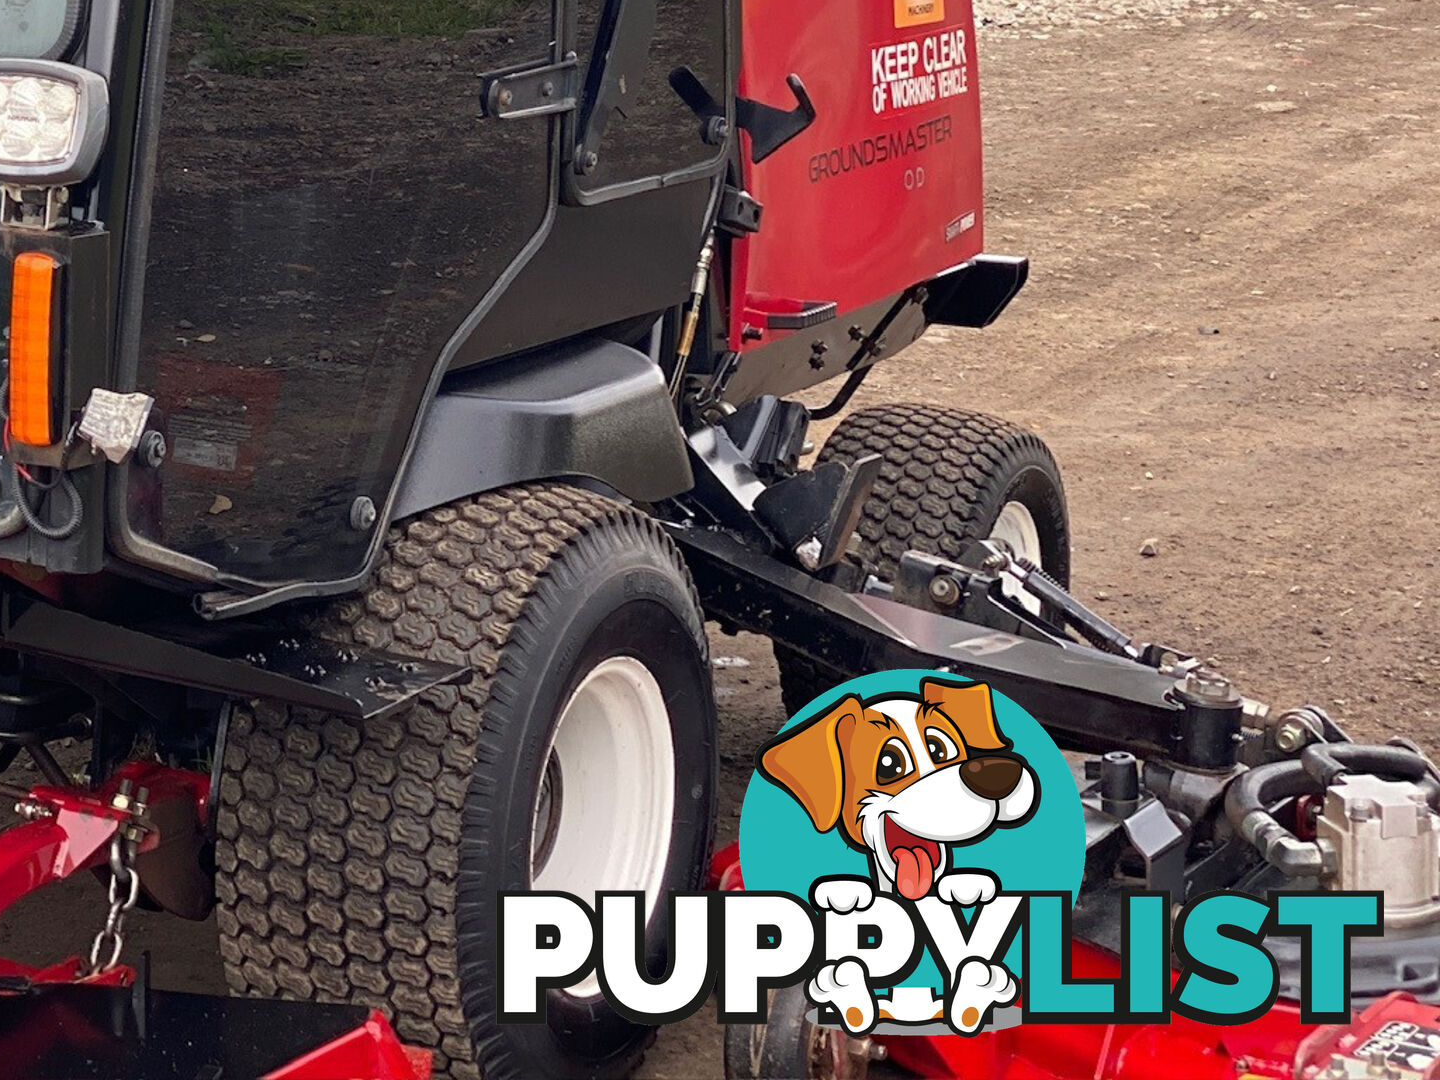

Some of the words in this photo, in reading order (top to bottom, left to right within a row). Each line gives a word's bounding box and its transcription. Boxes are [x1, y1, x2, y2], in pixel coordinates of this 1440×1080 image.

[871, 40, 919, 85] KEEP
[923, 29, 967, 74] CLEAR
[872, 81, 888, 114] OF
[891, 73, 936, 109] WORKING
[937, 65, 968, 99] VEHICLE
[809, 114, 952, 183] GROUNDSMASTER
